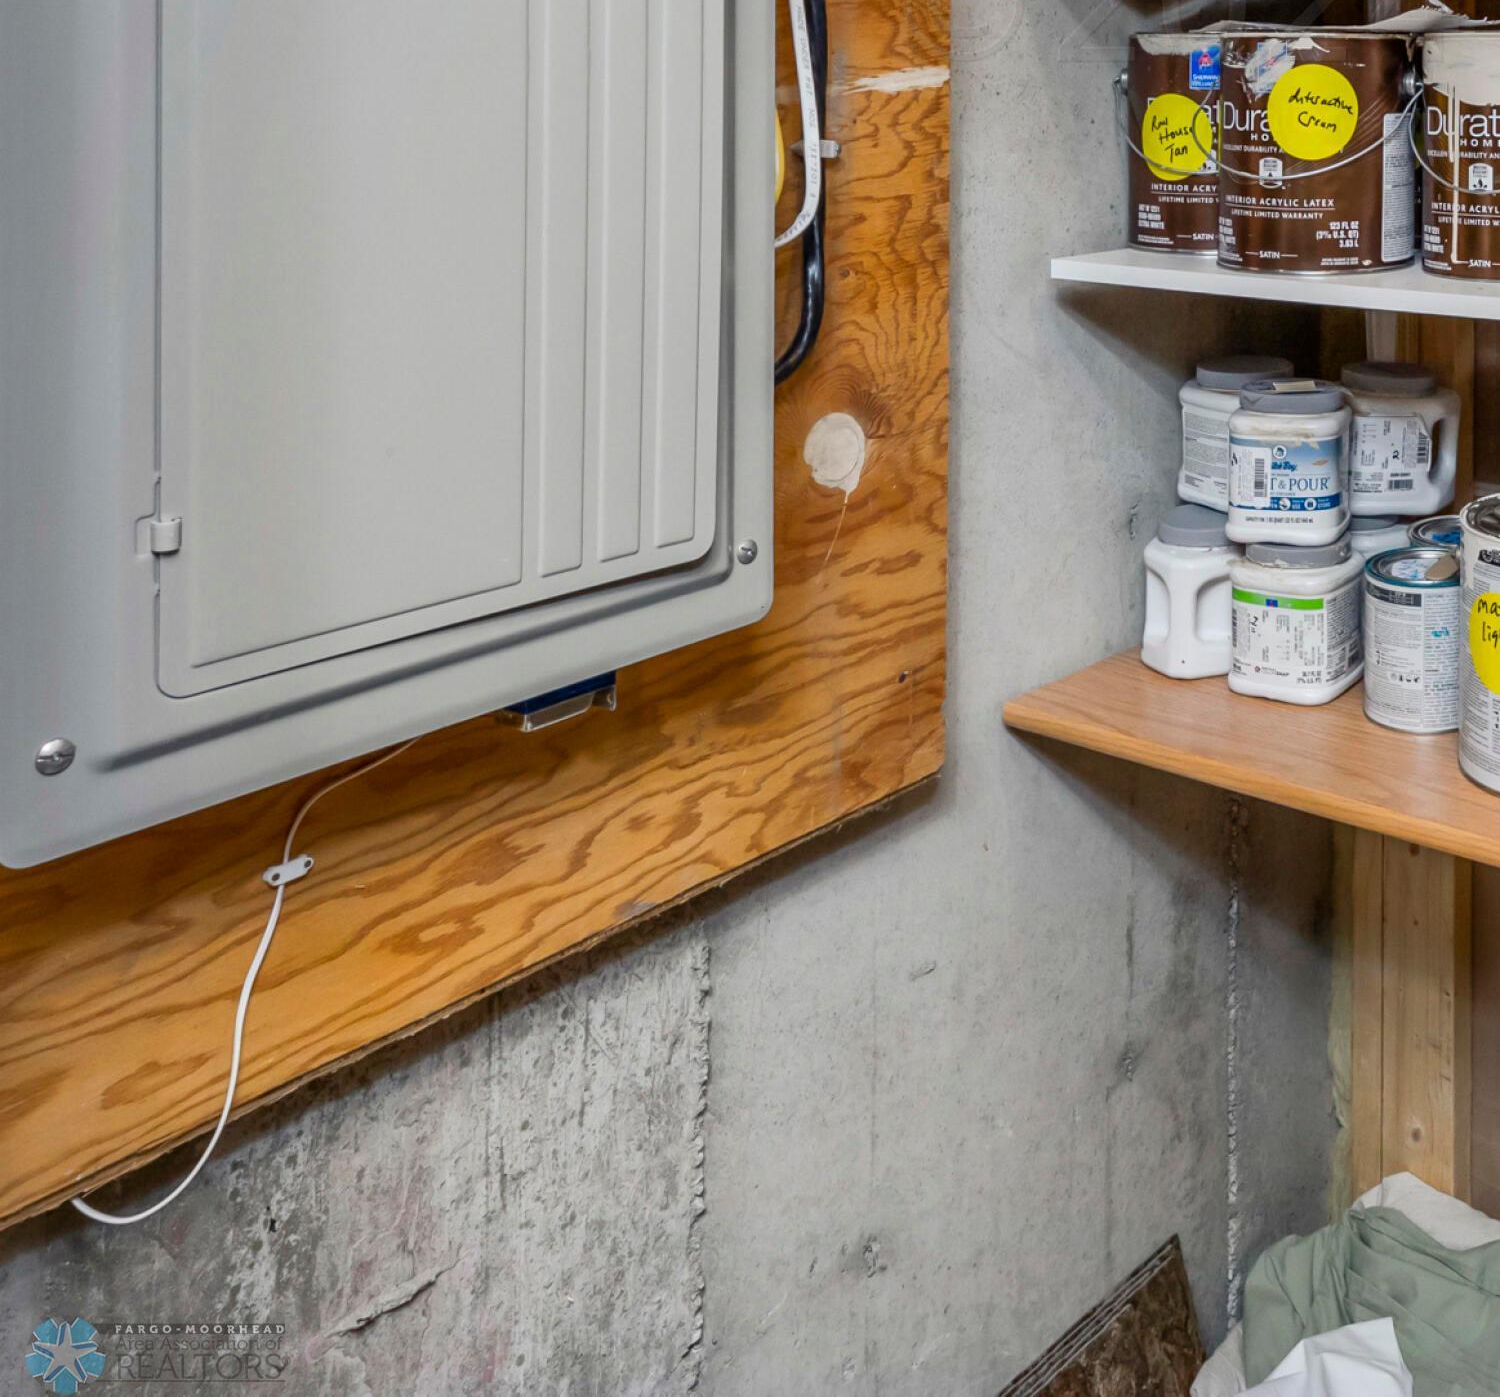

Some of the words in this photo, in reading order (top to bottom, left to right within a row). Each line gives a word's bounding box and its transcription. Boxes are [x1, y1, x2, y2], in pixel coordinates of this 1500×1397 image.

[1297, 110, 1338, 134] Cream
[1164, 143, 1189, 164] Tan
[1151, 183, 1189, 192] INTERIOR
[1186, 196, 1214, 204] LIMITED
[1259, 198, 1299, 208] ACRYLIC
[1303, 198, 1335, 208] LATEX
[1254, 210, 1281, 219] LIMITED
[1281, 211, 1324, 220] WARRANTY
[1463, 217, 1491, 227] LIMITED
[1192, 233, 1215, 241] SATIN
[1259, 250, 1281, 259] SATIN
[1468, 259, 1492, 268] SATIN
[1289, 477, 1330, 492] POUR
